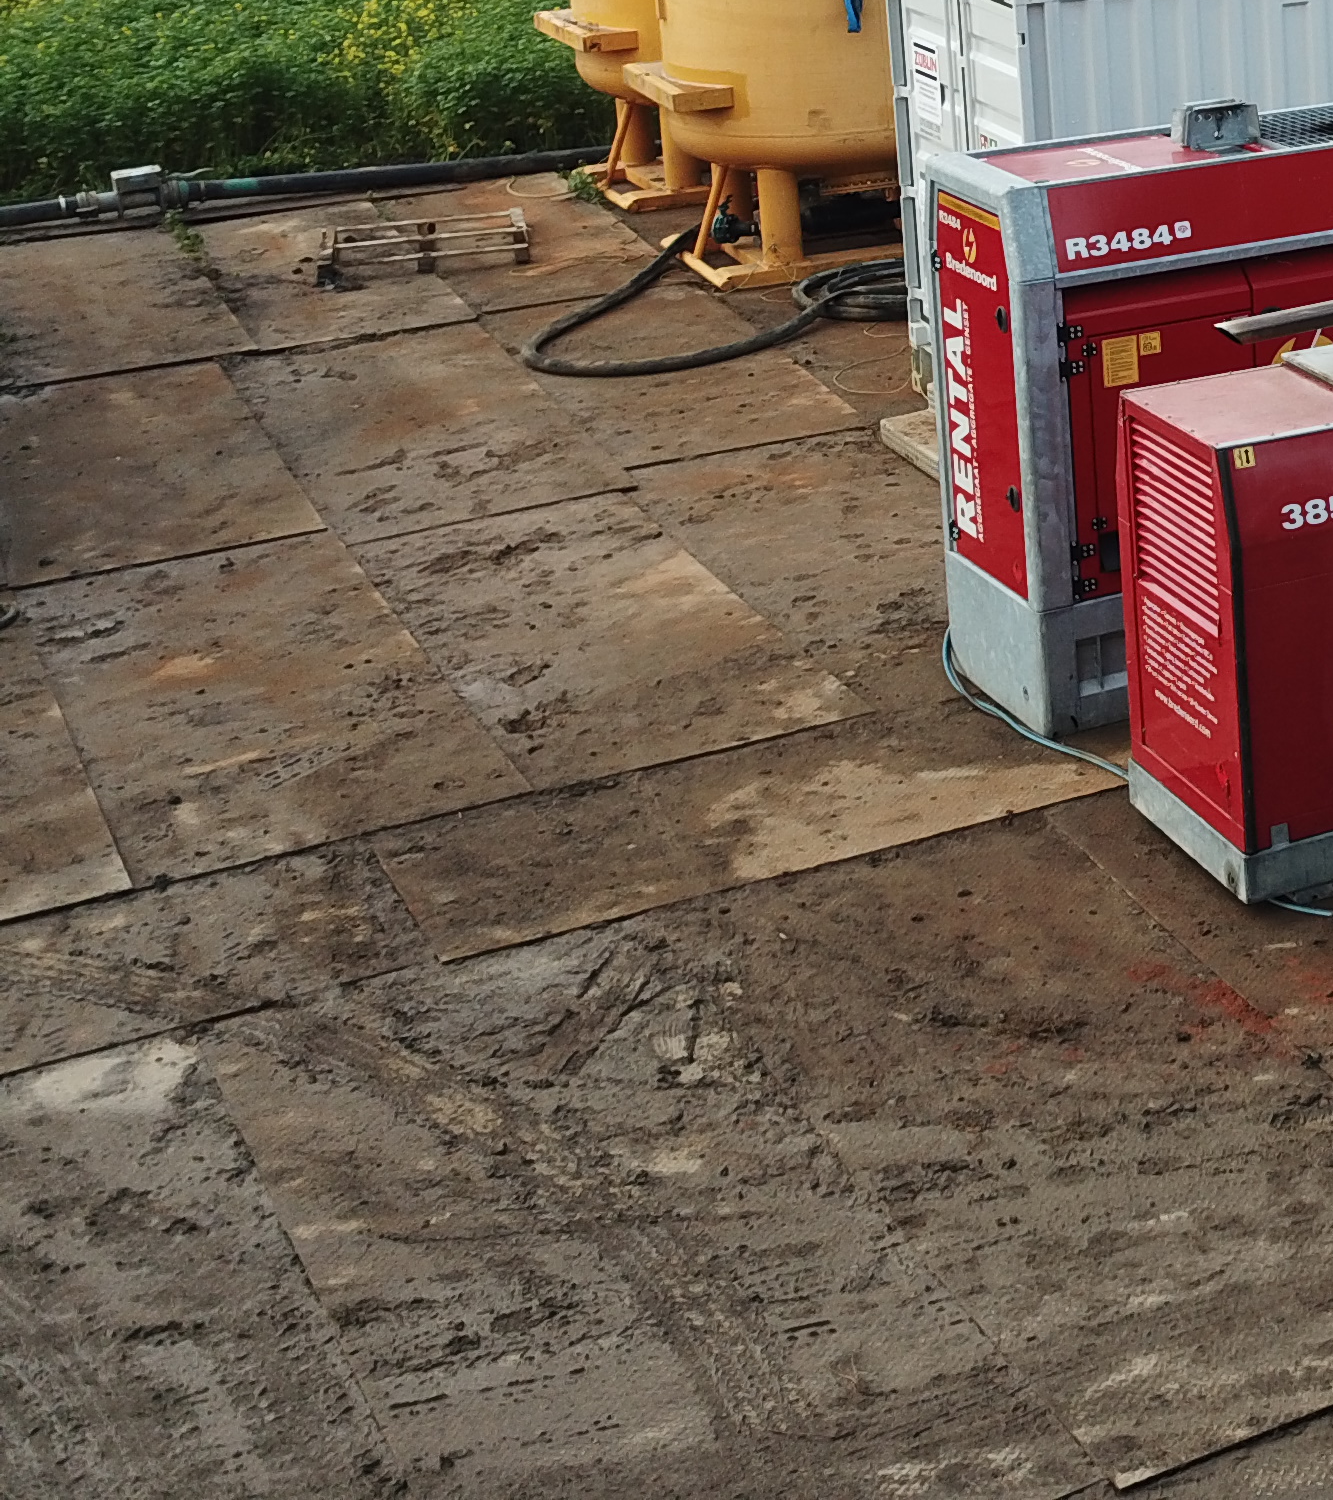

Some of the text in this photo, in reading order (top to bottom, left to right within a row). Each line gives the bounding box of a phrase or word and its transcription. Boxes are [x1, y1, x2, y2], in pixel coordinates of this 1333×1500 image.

[1065, 224, 1173, 260] R3484
[945, 251, 998, 292] Bredenoord
[943, 298, 978, 539] RENTAL
